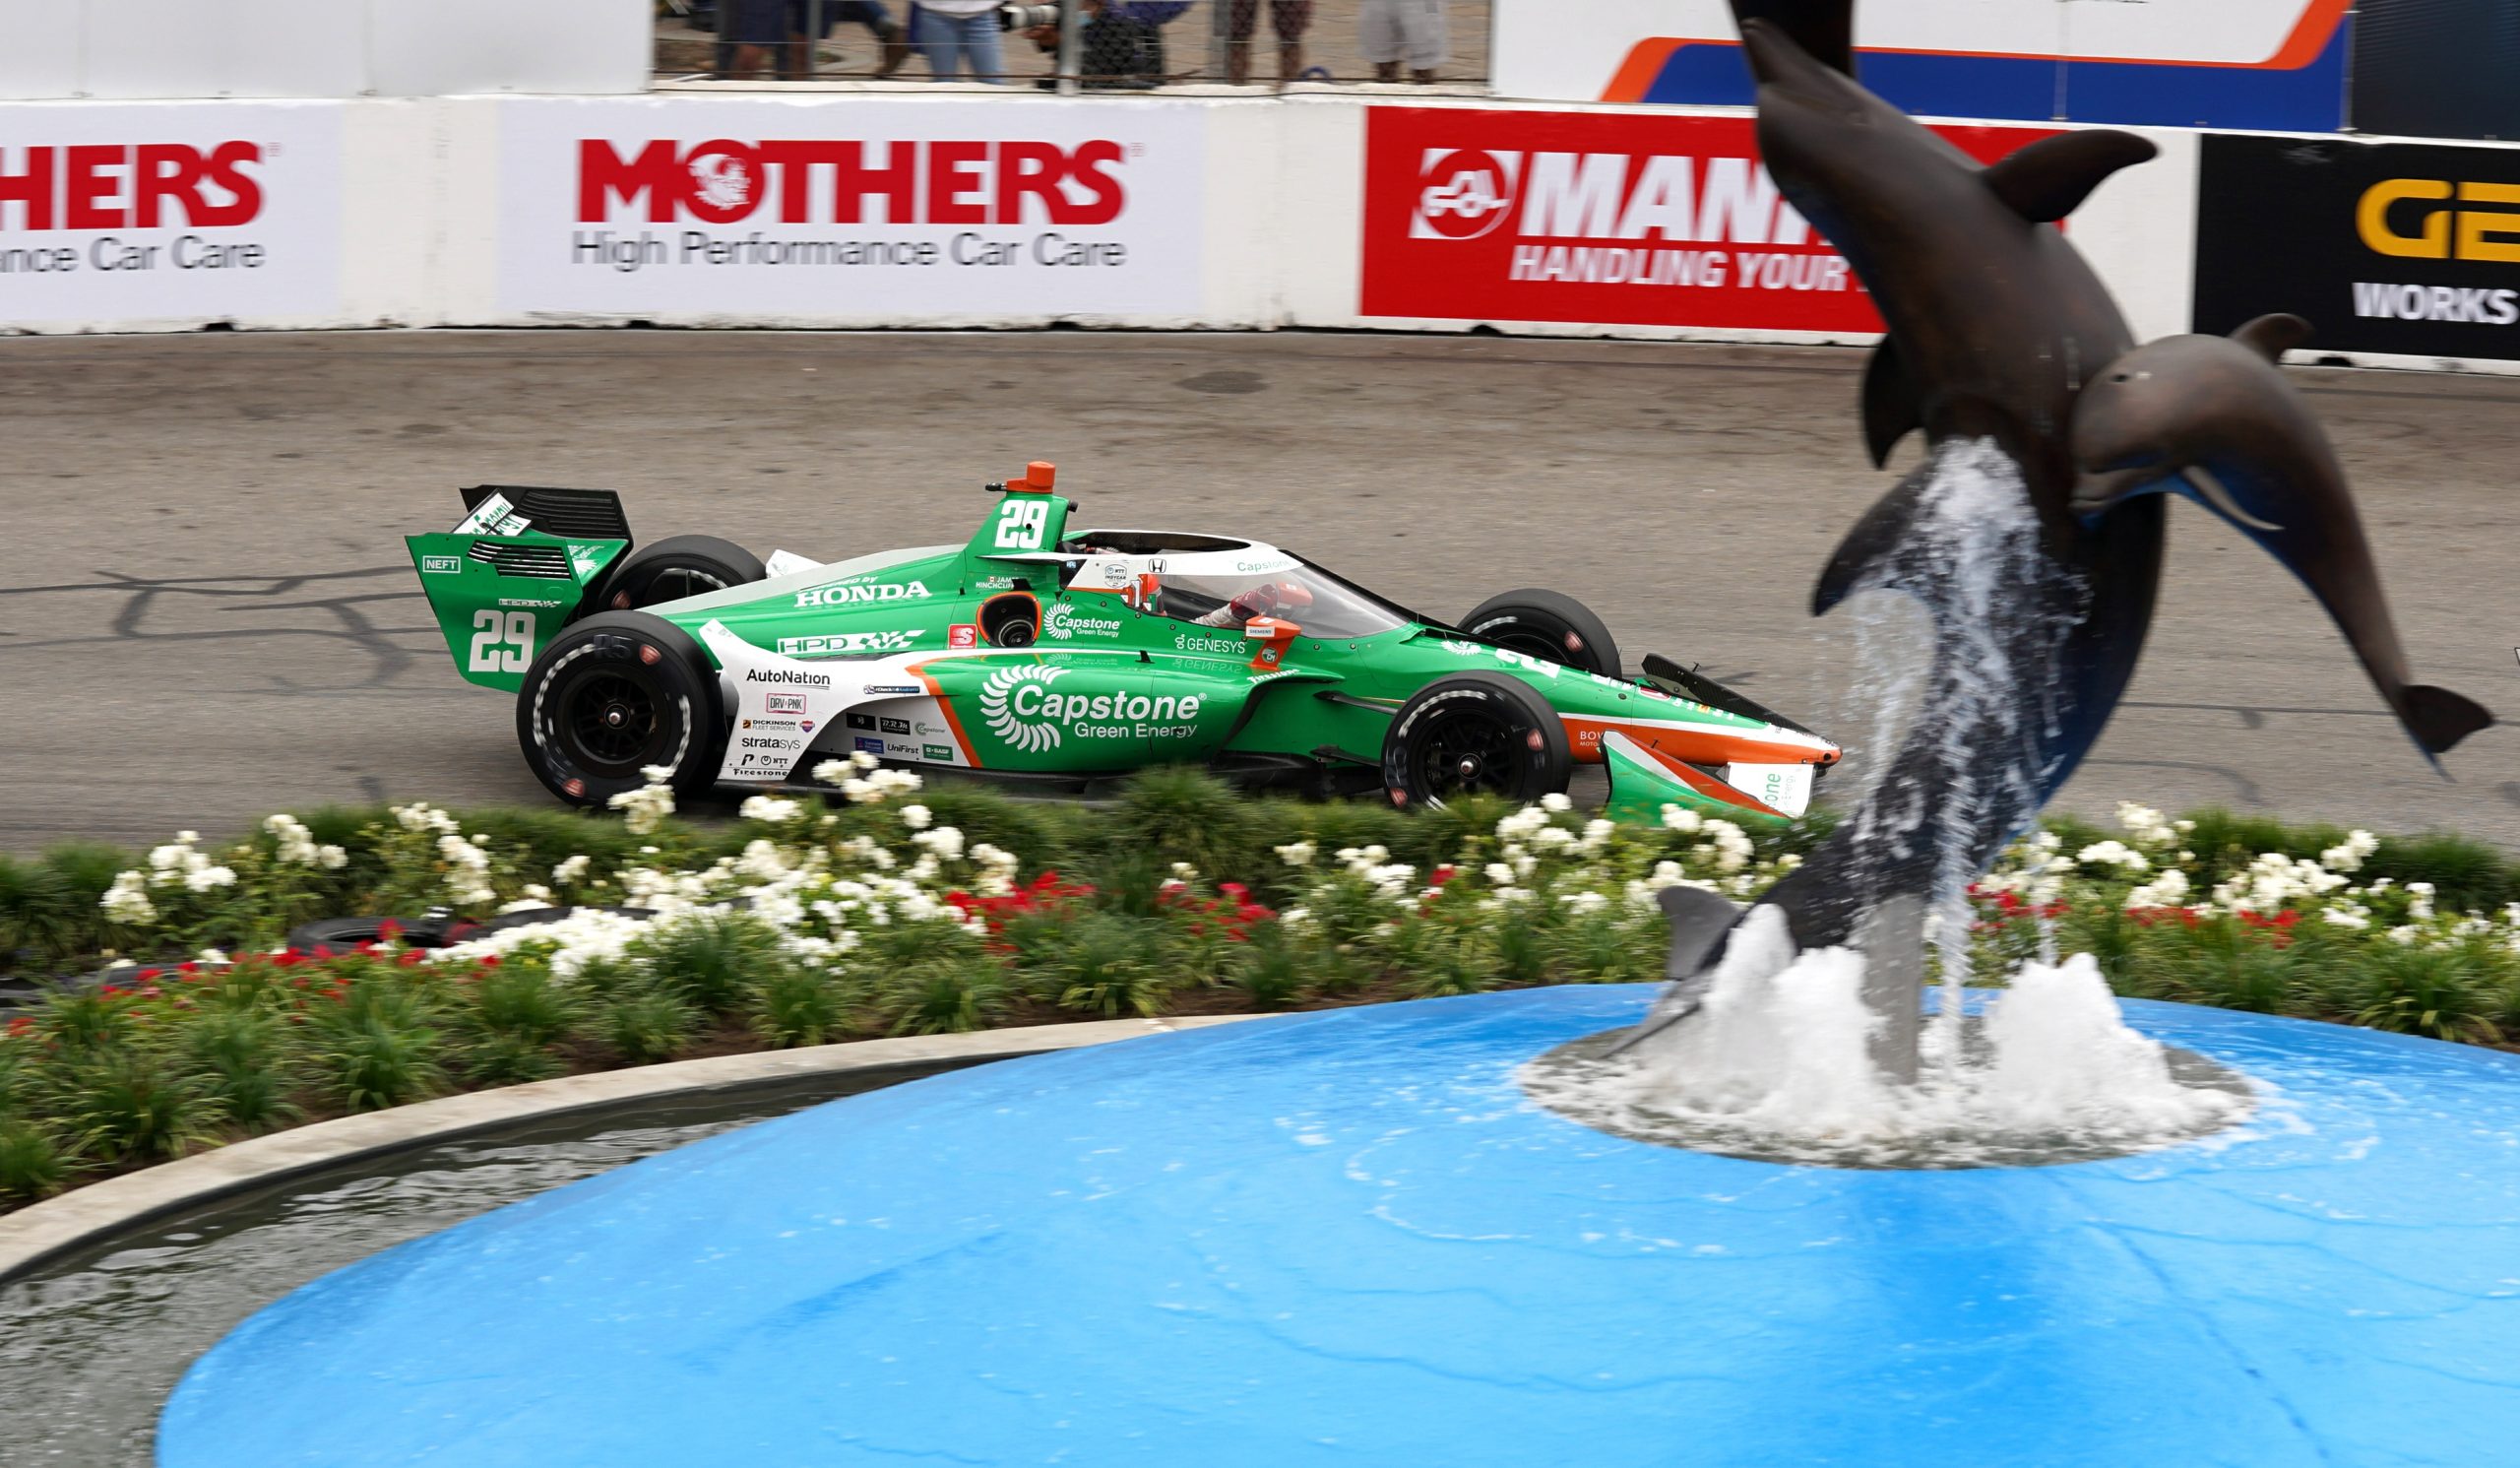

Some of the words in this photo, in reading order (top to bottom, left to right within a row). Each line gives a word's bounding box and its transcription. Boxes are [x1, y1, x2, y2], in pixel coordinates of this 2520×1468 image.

[576, 139, 1126, 224] MOTHERS
[1518, 152, 1832, 245] MANI
[2356, 178, 2520, 263] GE
[0, 247, 80, 273] nce
[89, 236, 161, 271] Car
[170, 234, 267, 269] Care
[572, 231, 668, 273] High
[680, 230, 939, 266] Performance
[949, 231, 1022, 266] Car
[1033, 231, 1127, 267] Care
[1508, 245, 1728, 287] HANDLING
[1736, 251, 1852, 291] YOUR
[2352, 282, 2520, 325] WORKS
[994, 499, 1049, 549] 29
[425, 558, 458, 570] NEFT
[793, 581, 932, 607] HONDA
[1055, 615, 1120, 630] Capstone
[1098, 628, 1119, 638] Energy
[469, 609, 536, 673] 29
[781, 637, 848, 653] HPD
[1186, 638, 1246, 655] GENESYS
[746, 669, 831, 684] AutoNation
[770, 697, 785, 709] DRV
[788, 698, 802, 710] PNK
[1014, 684, 1200, 726] Capstone
[1074, 722, 1129, 738] Green
[1136, 723, 1198, 739] Energy
[741, 737, 801, 751] stratasys
[887, 743, 919, 754] UniFirst
